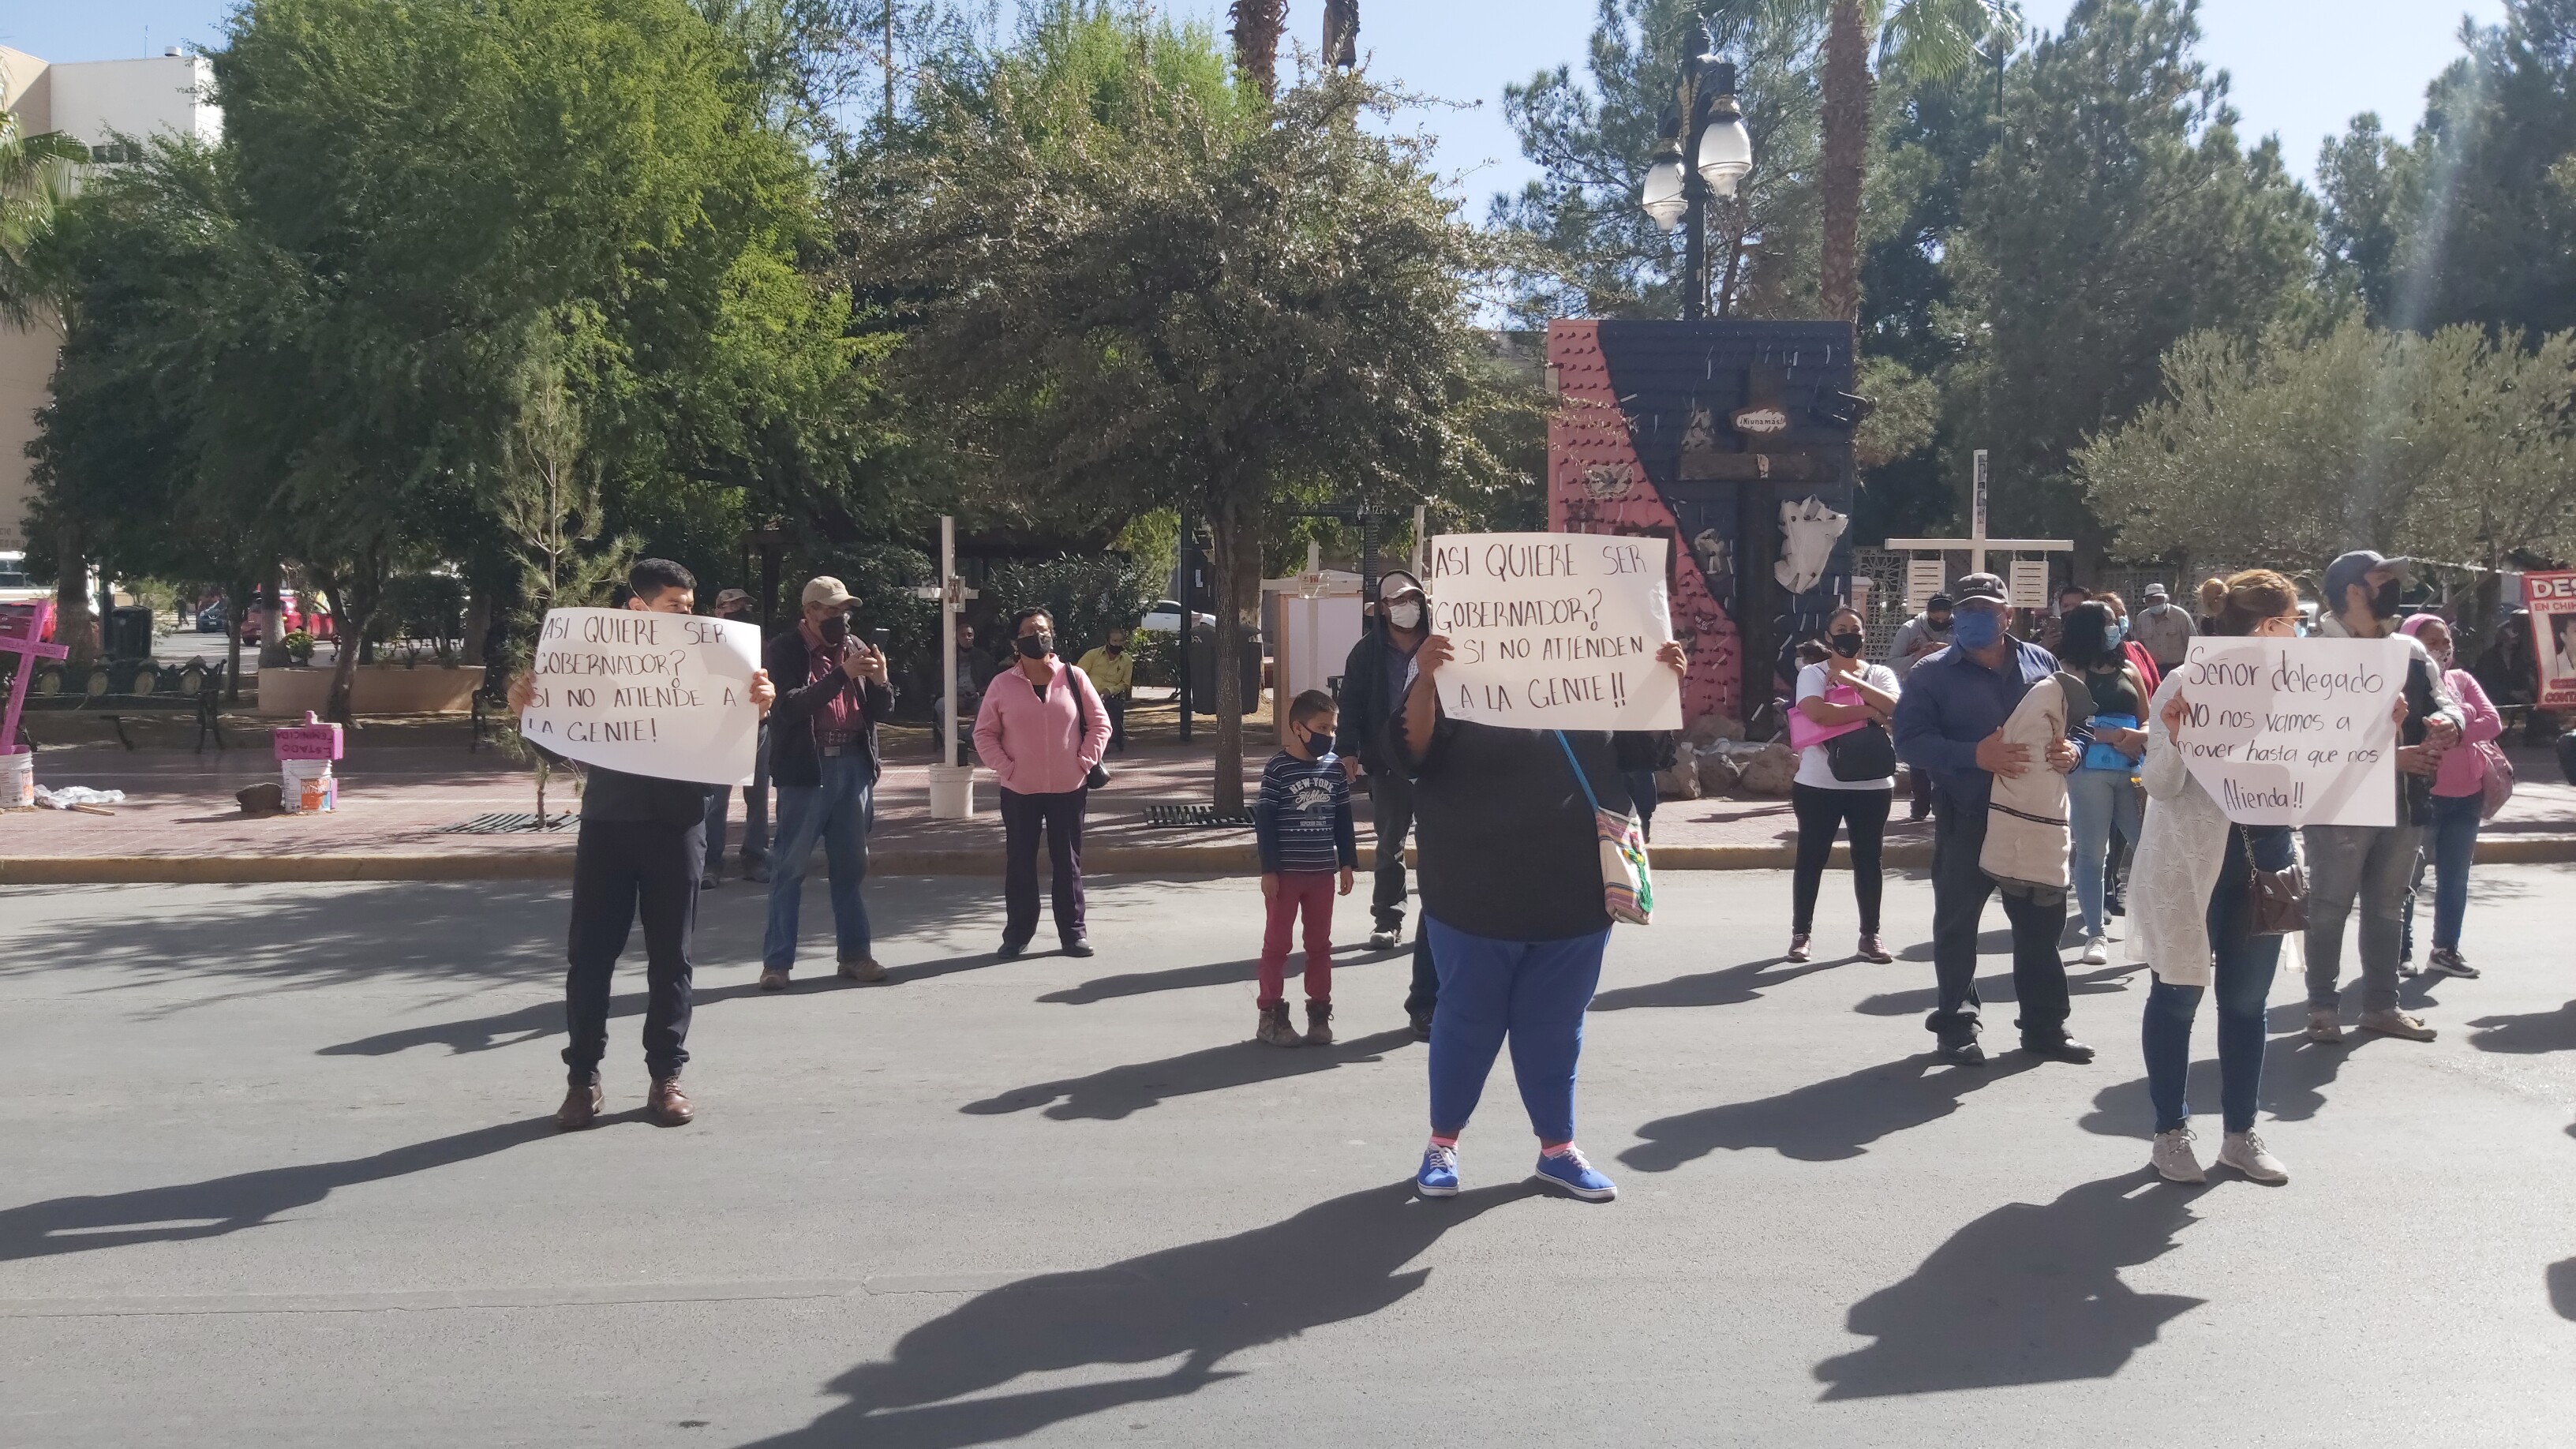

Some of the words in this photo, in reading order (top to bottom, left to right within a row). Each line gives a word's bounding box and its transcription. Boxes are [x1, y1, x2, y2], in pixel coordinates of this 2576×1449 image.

[1435, 546, 1470, 579] ASI
[1486, 543, 1578, 582] QUIERE
[1602, 544, 1647, 576] SER
[1435, 588, 1603, 634] GOBERNADOR?
[2534, 602, 2549, 612] EN
[542, 617, 570, 641] ASI
[584, 616, 660, 646] QUIERE
[684, 621, 727, 645] SER
[1463, 639, 1485, 665] SI
[1500, 638, 1530, 661] NO
[1542, 636, 1643, 661] ATIENDEN
[534, 650, 686, 689] GOBERNADOR?
[2188, 646, 2260, 687] Señor
[2271, 650, 2383, 701] delegado
[567, 687, 596, 708] NO
[614, 686, 705, 708] ATIENDE
[723, 687, 737, 707] A
[1461, 683, 1474, 709] A
[1485, 685, 1512, 712] LA
[1528, 672, 1626, 709] GENTE!!
[530, 718, 553, 734] LA
[567, 717, 657, 743] GENTE!
[2220, 710, 2255, 728] nos
[2266, 712, 2324, 733] vamos
[2336, 715, 2350, 732] a
[2177, 740, 2235, 758] mover
[2246, 739, 2297, 762] hasta
[2308, 750, 2338, 768] que
[2347, 749, 2379, 764] nos
[1289, 777, 1310, 795] NEW
[1312, 777, 1334, 793] YORK
